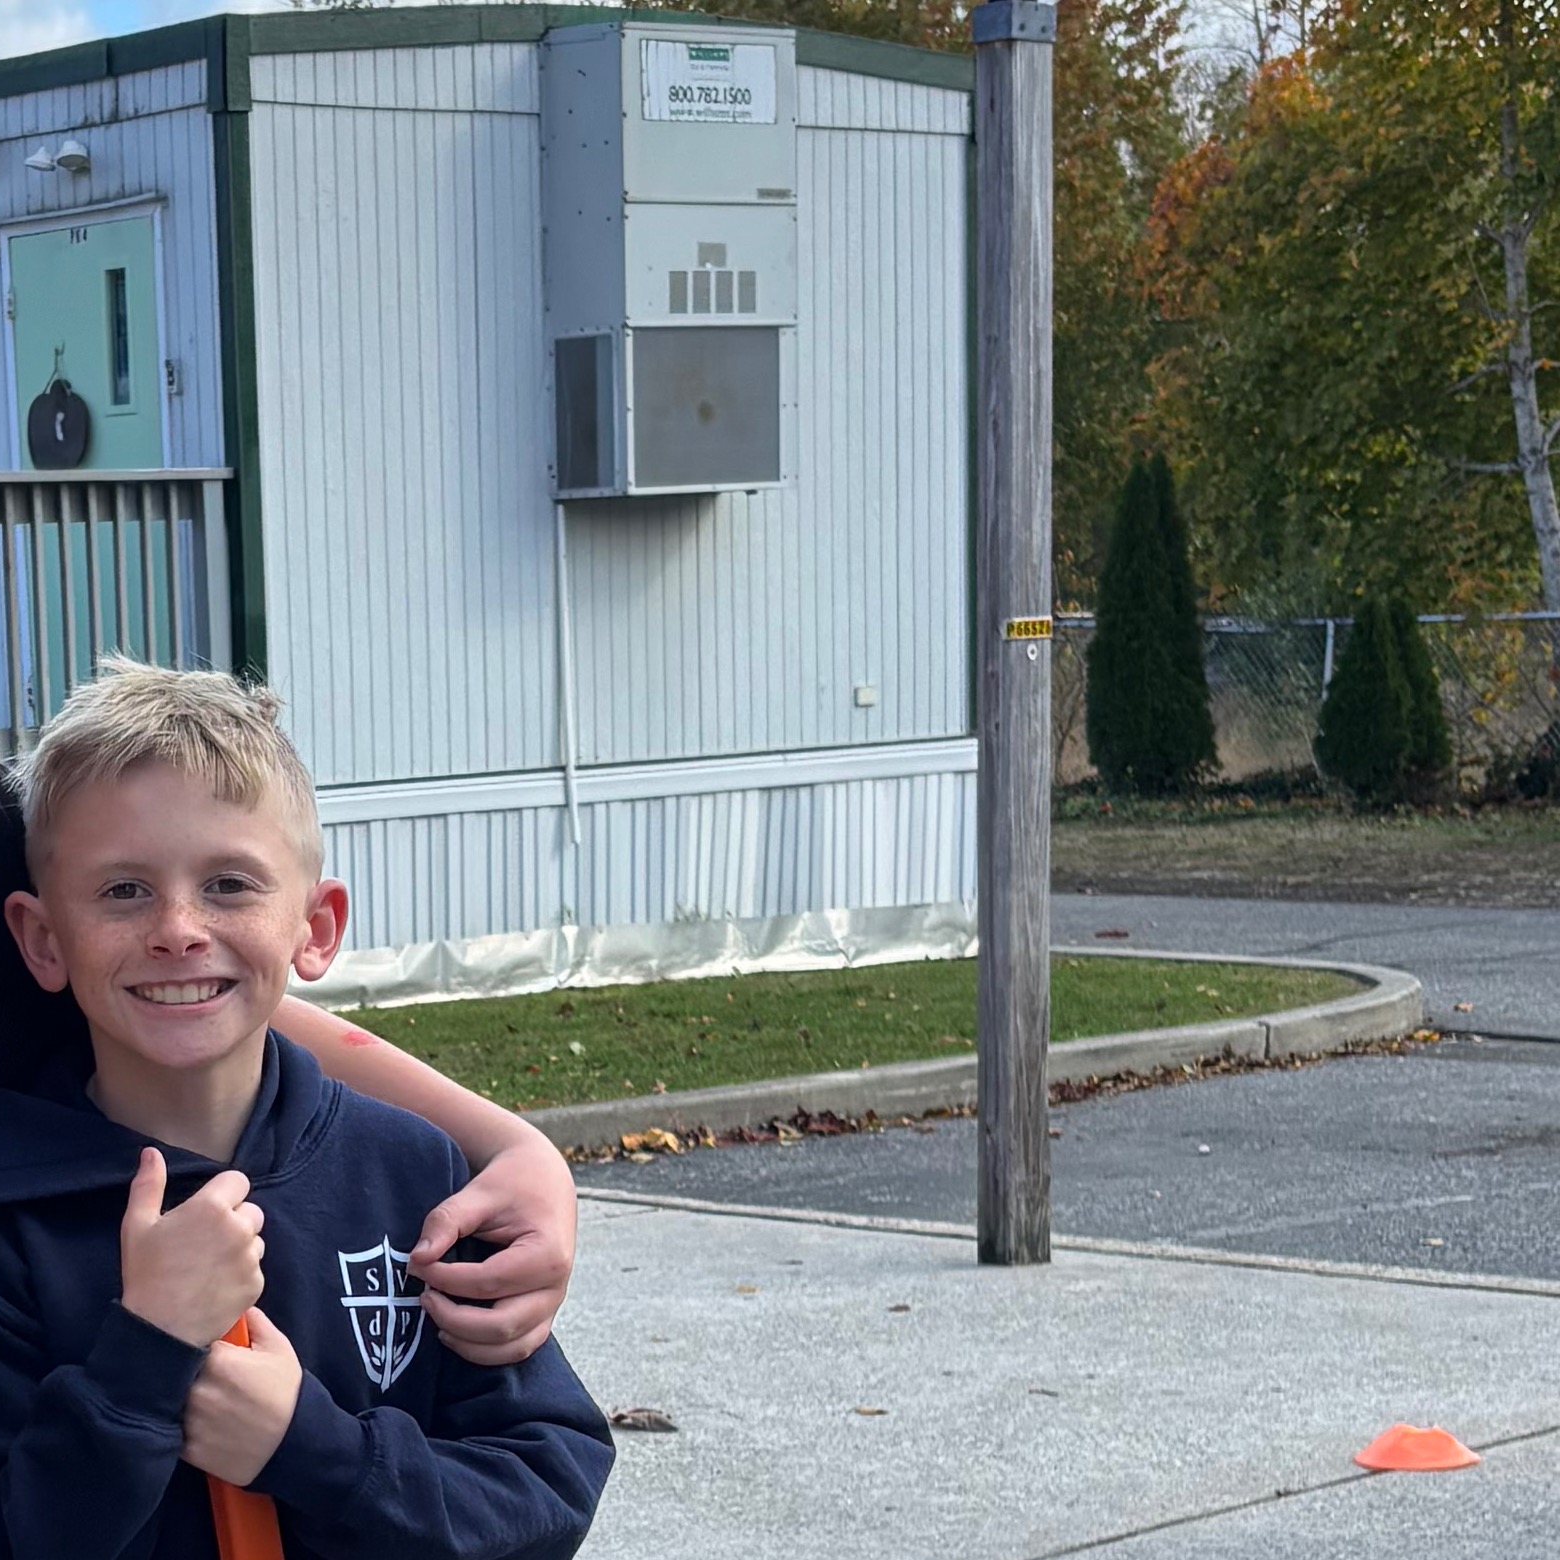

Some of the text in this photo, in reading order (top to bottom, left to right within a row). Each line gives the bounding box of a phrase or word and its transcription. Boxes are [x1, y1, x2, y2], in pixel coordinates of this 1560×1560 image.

[668, 85, 751, 104] 800.782.1500
[365, 1267, 407, 1291] S V
[369, 1310, 410, 1335] d P
